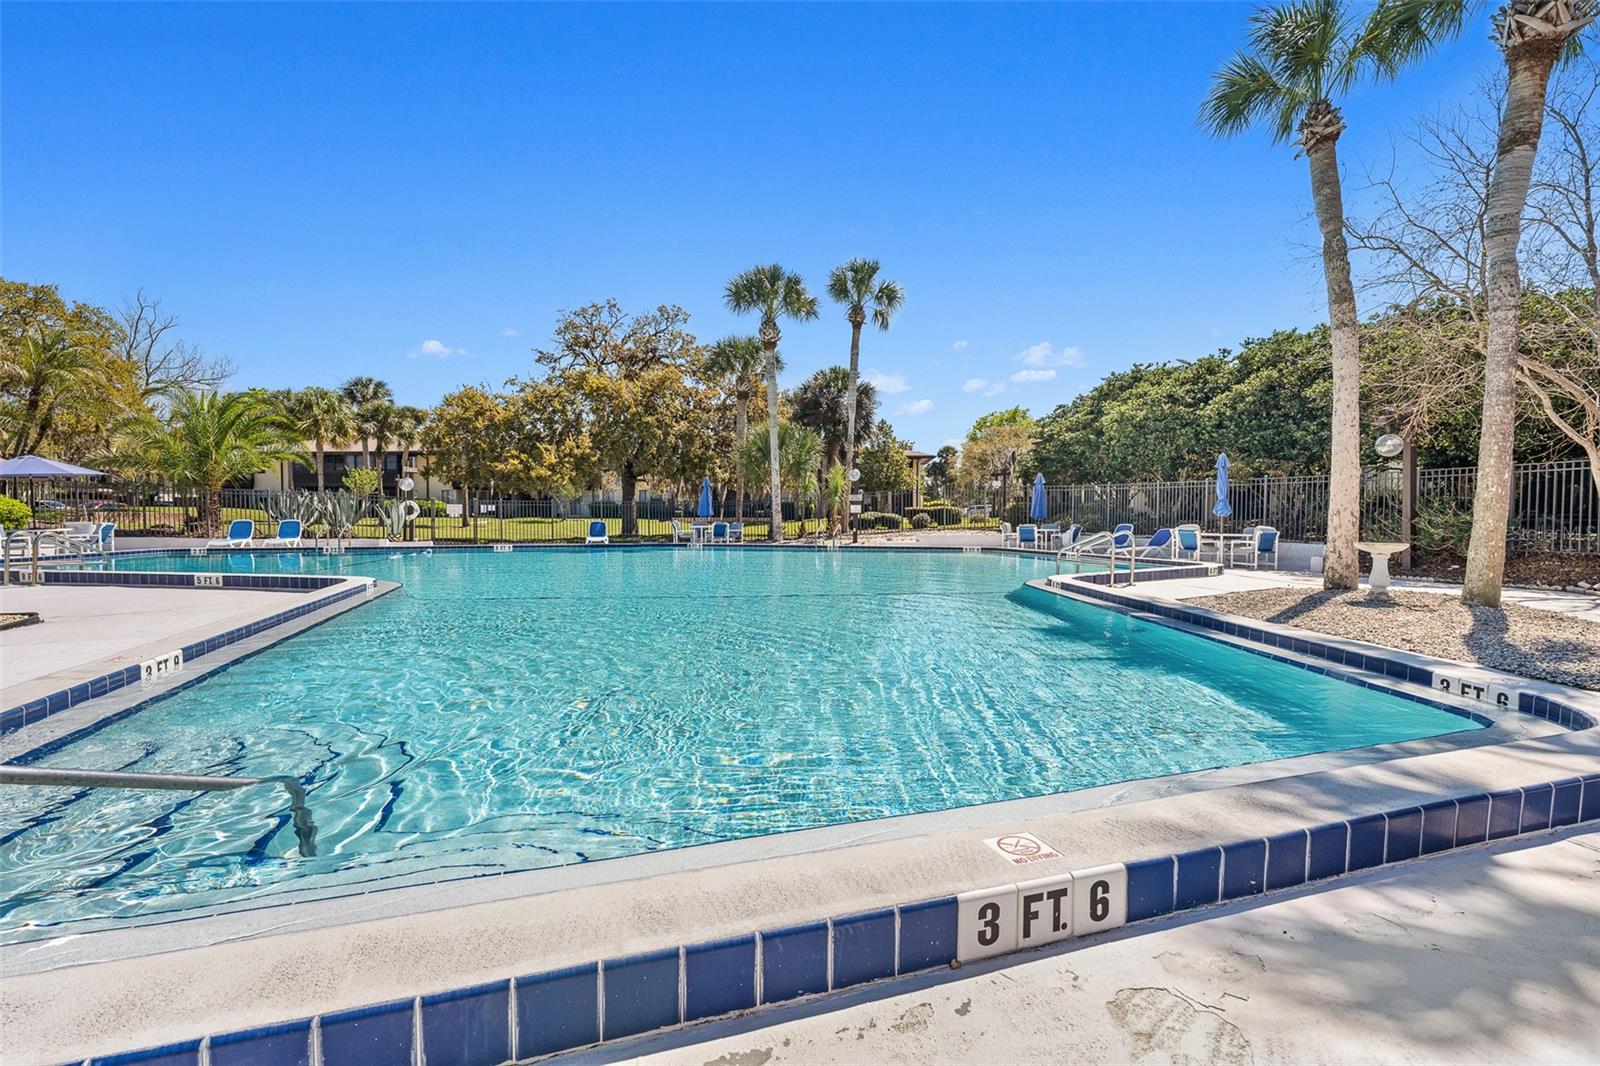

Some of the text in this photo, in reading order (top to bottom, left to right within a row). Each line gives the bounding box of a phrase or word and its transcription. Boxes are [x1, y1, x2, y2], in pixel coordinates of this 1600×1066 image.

[196, 576, 202, 585] 5
[156, 658, 169, 673] FT
[1460, 682, 1485, 700] FT
[1012, 857, 1028, 865] NO
[977, 879, 1110, 946] 3 FT. 6
